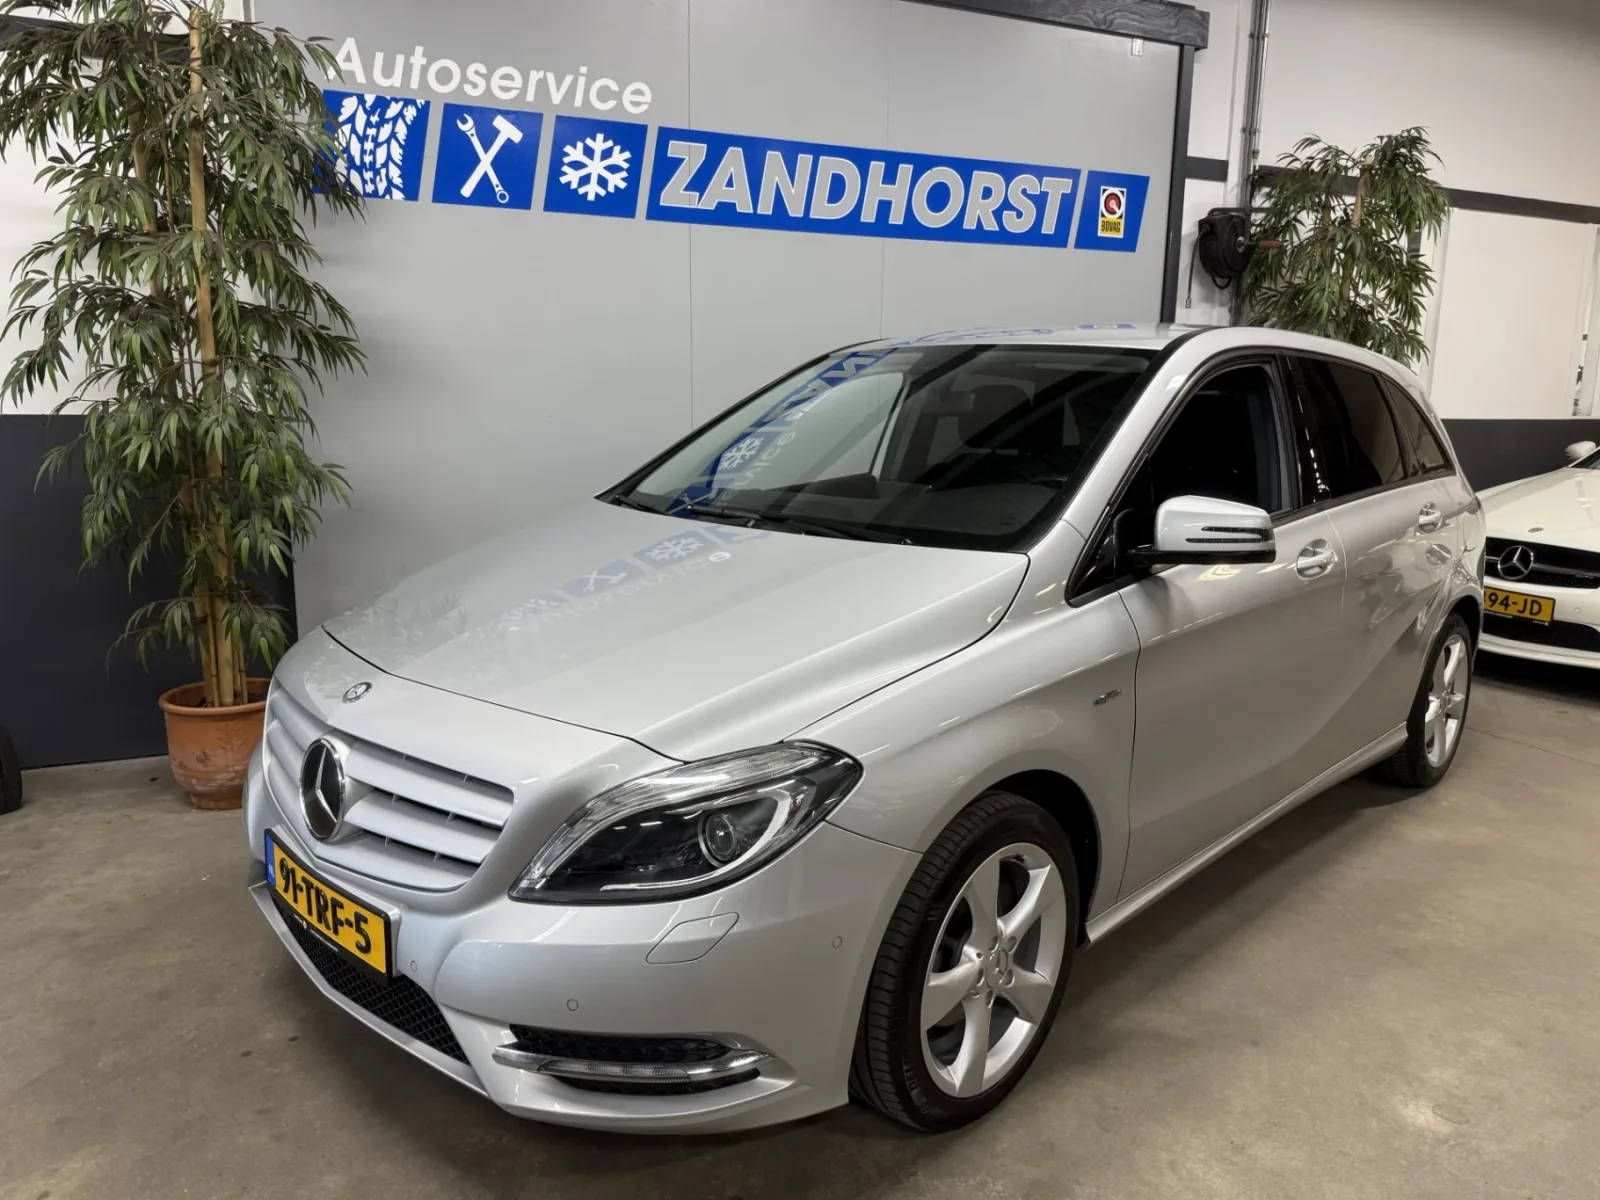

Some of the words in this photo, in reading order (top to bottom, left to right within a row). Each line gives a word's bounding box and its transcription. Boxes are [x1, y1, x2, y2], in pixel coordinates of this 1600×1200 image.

[324, 36, 652, 114] Autoservice
[659, 140, 1073, 234] ZANDHORST
[1101, 220, 1121, 233] BOVAG
[1484, 591, 1542, 616] 94-JD
[279, 857, 372, 954] 91-TRF-5
